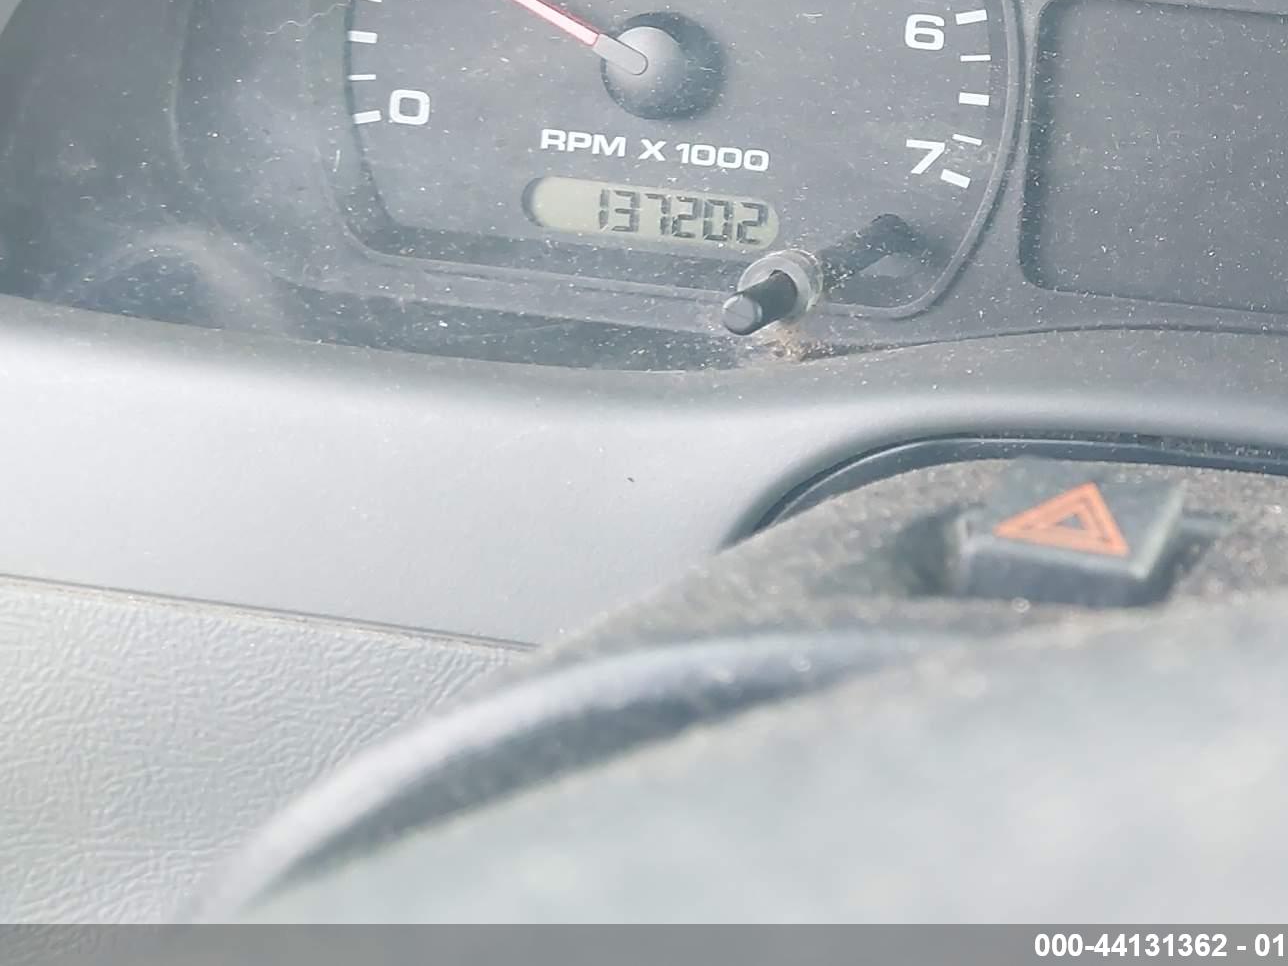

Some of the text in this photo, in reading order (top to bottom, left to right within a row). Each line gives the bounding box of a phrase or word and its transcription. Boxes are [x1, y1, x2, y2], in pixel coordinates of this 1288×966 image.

[904, 14, 945, 51] 6
[389, 89, 430, 125] 0
[540, 129, 770, 172] RPM X 1000
[905, 140, 945, 174] 7
[599, 189, 769, 245] 137202
